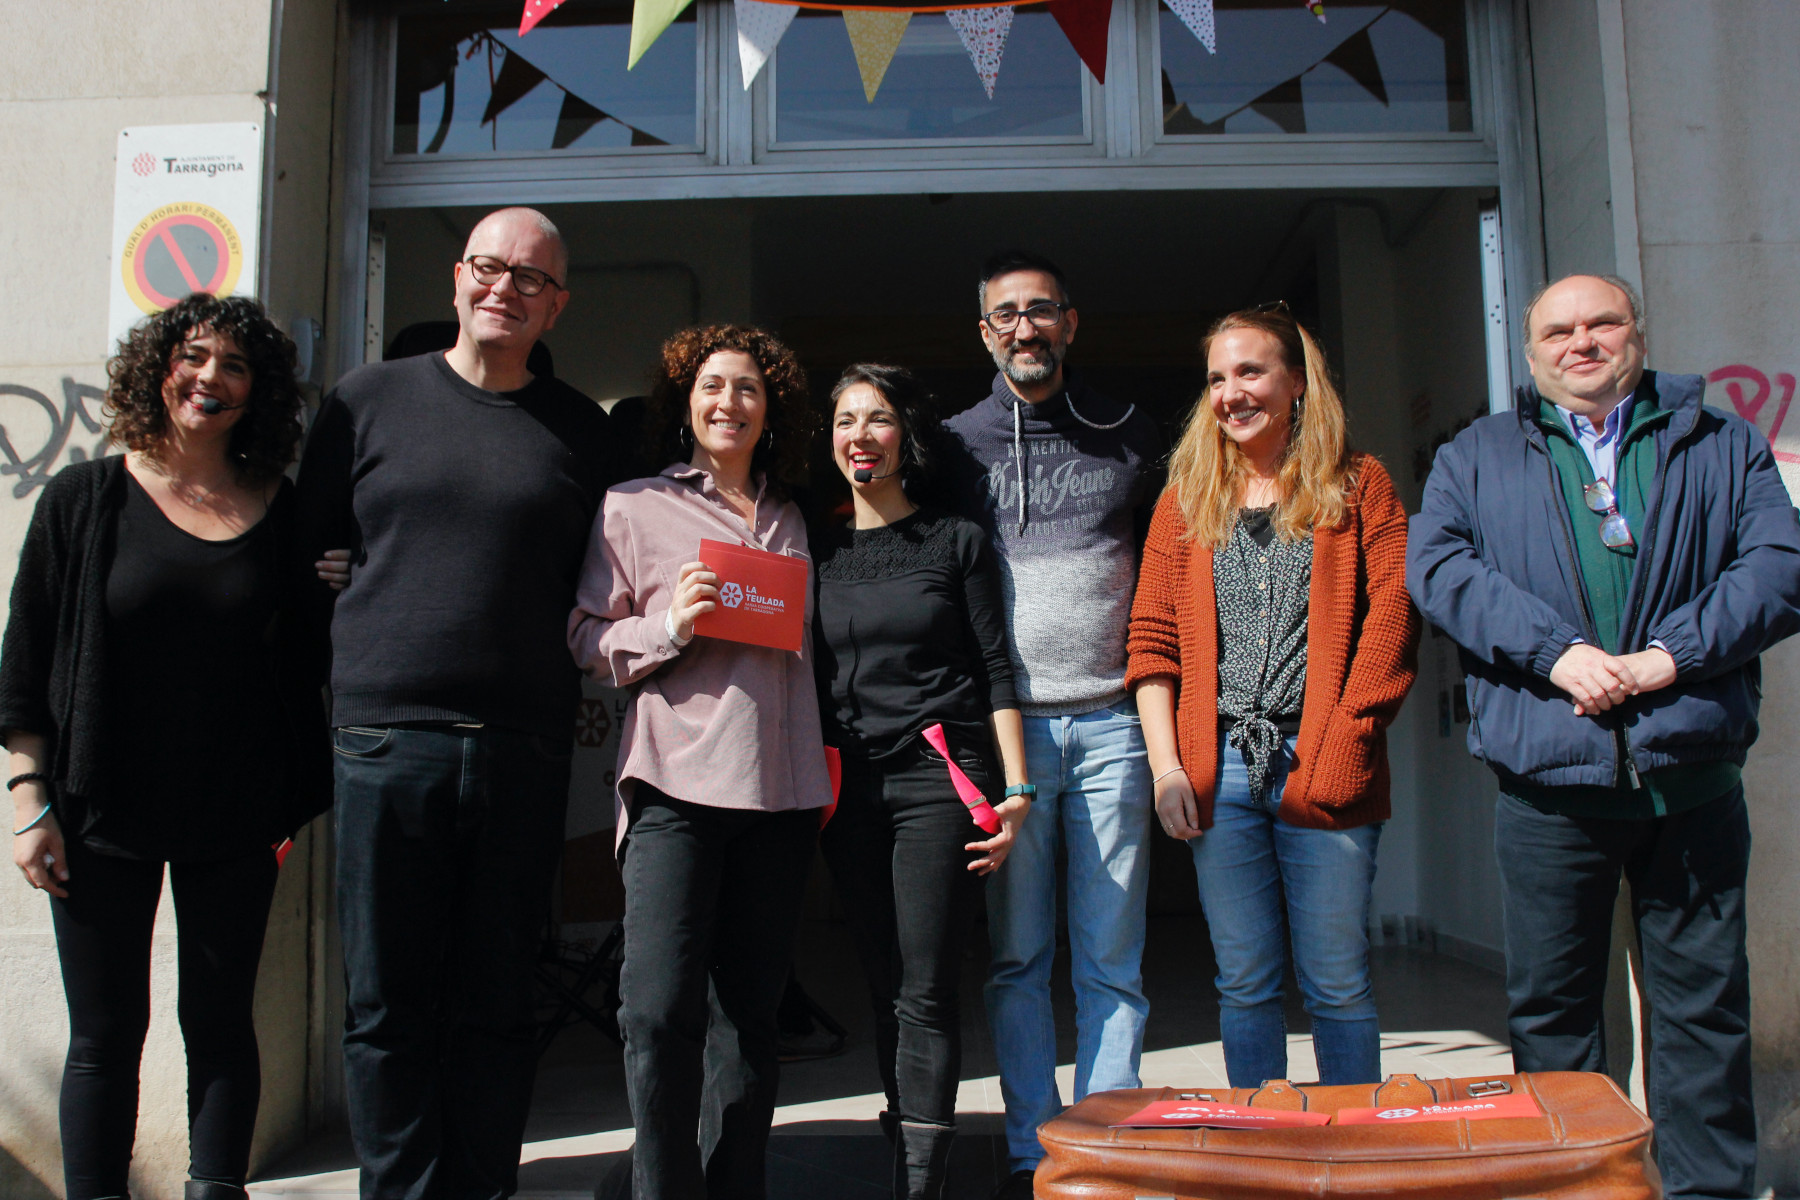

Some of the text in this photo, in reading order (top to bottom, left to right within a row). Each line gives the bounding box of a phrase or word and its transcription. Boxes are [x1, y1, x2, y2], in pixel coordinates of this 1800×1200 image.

[196, 206, 240, 256] PERMANENT
[745, 585, 757, 594] LA
[745, 594, 785, 607] TEULADA
